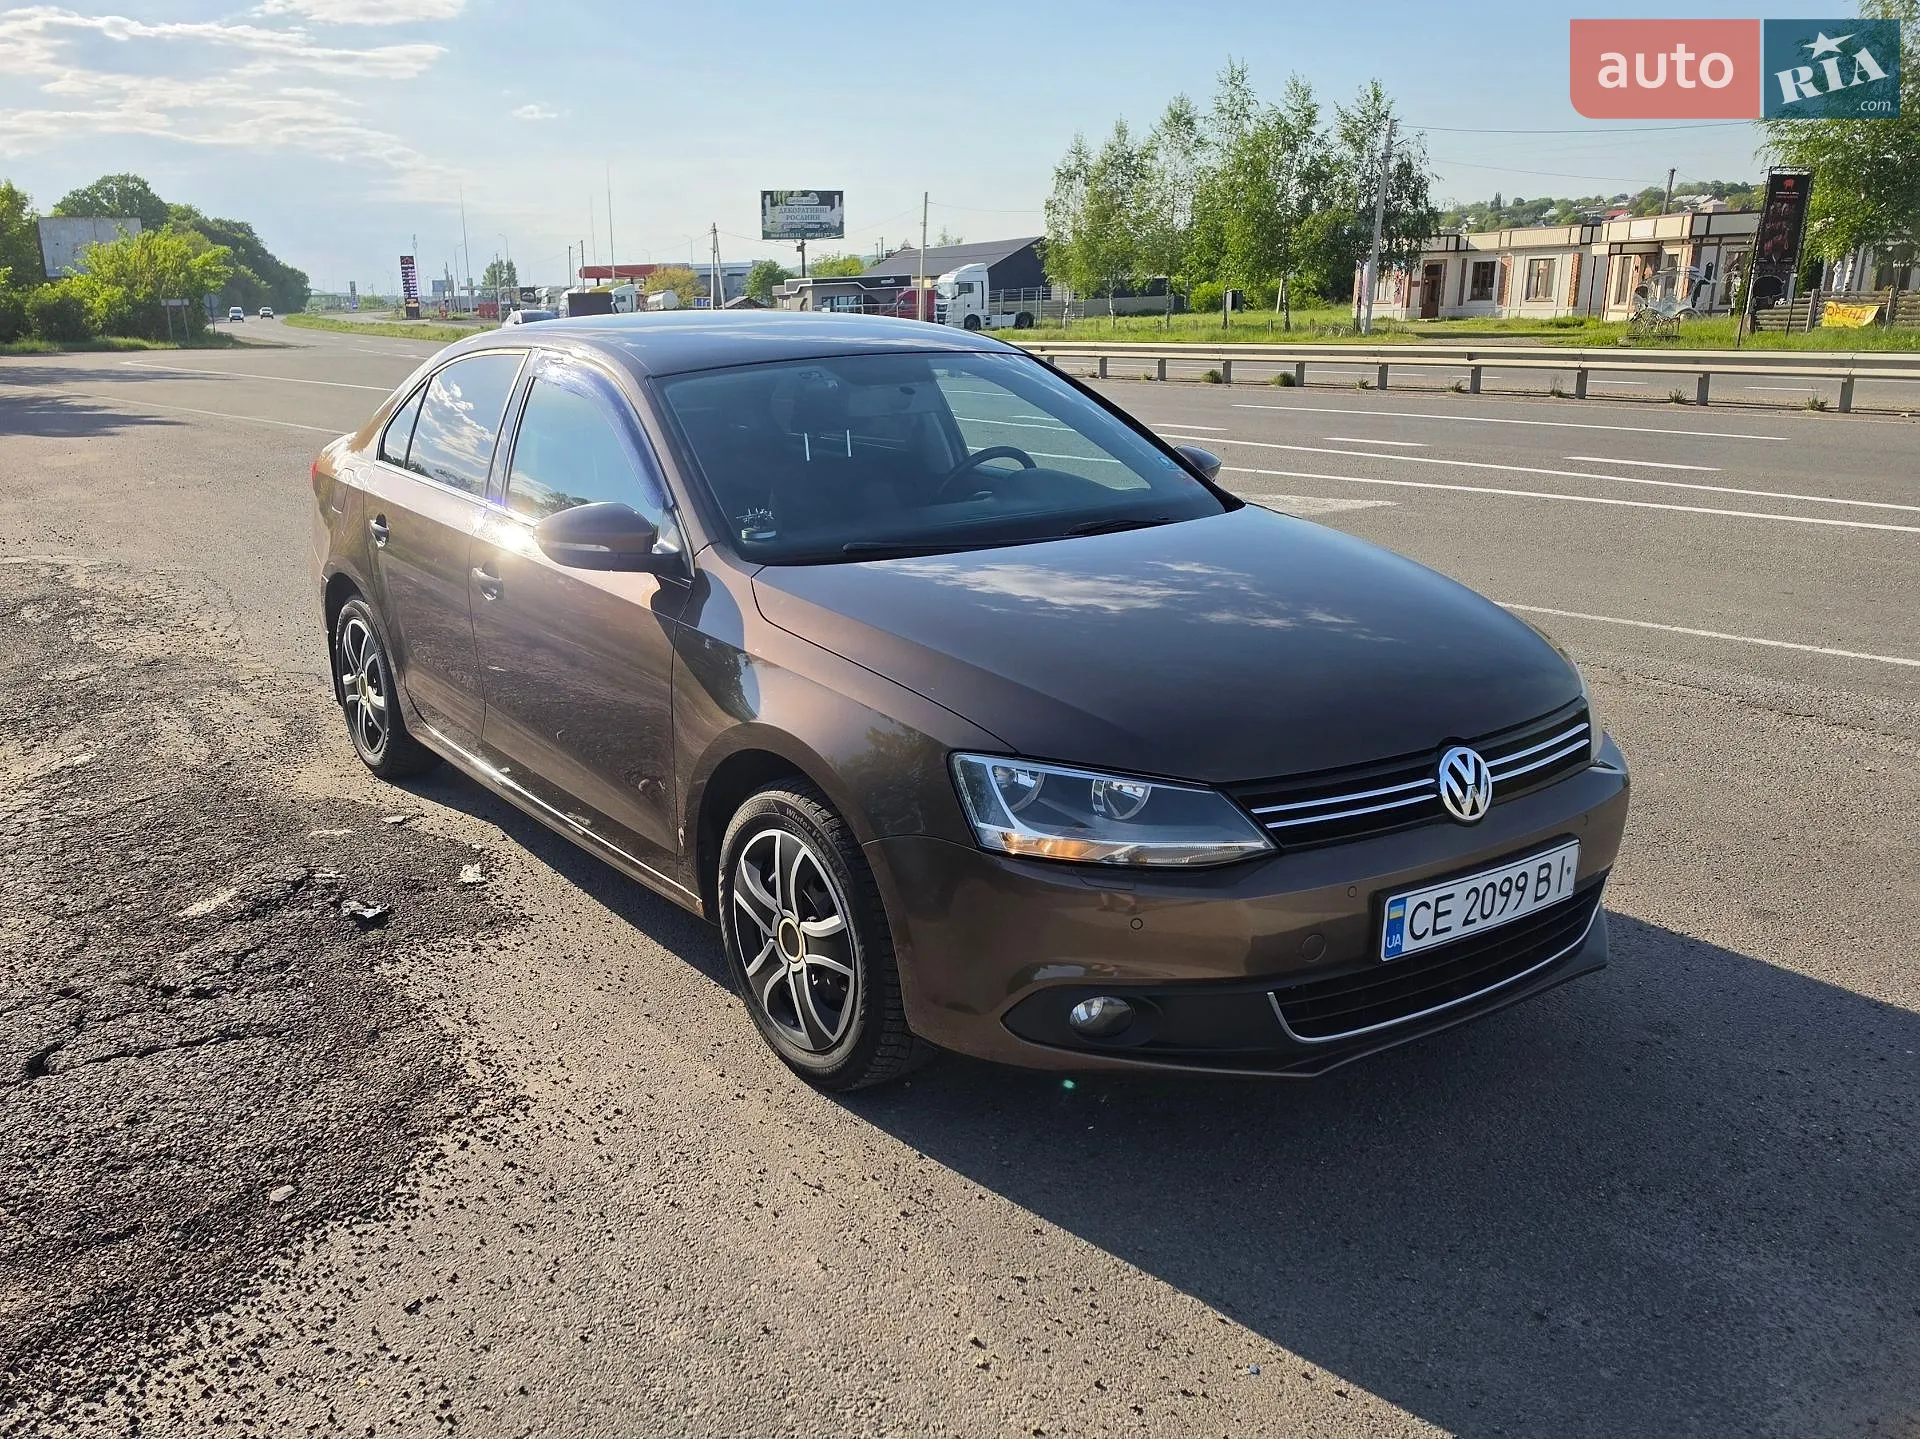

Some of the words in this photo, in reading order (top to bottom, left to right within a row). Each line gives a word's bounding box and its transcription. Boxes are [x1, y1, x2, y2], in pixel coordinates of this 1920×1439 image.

[1407, 892, 1456, 941] CE
[1461, 870, 1529, 928] 2099
[1386, 933, 1402, 949] UA
